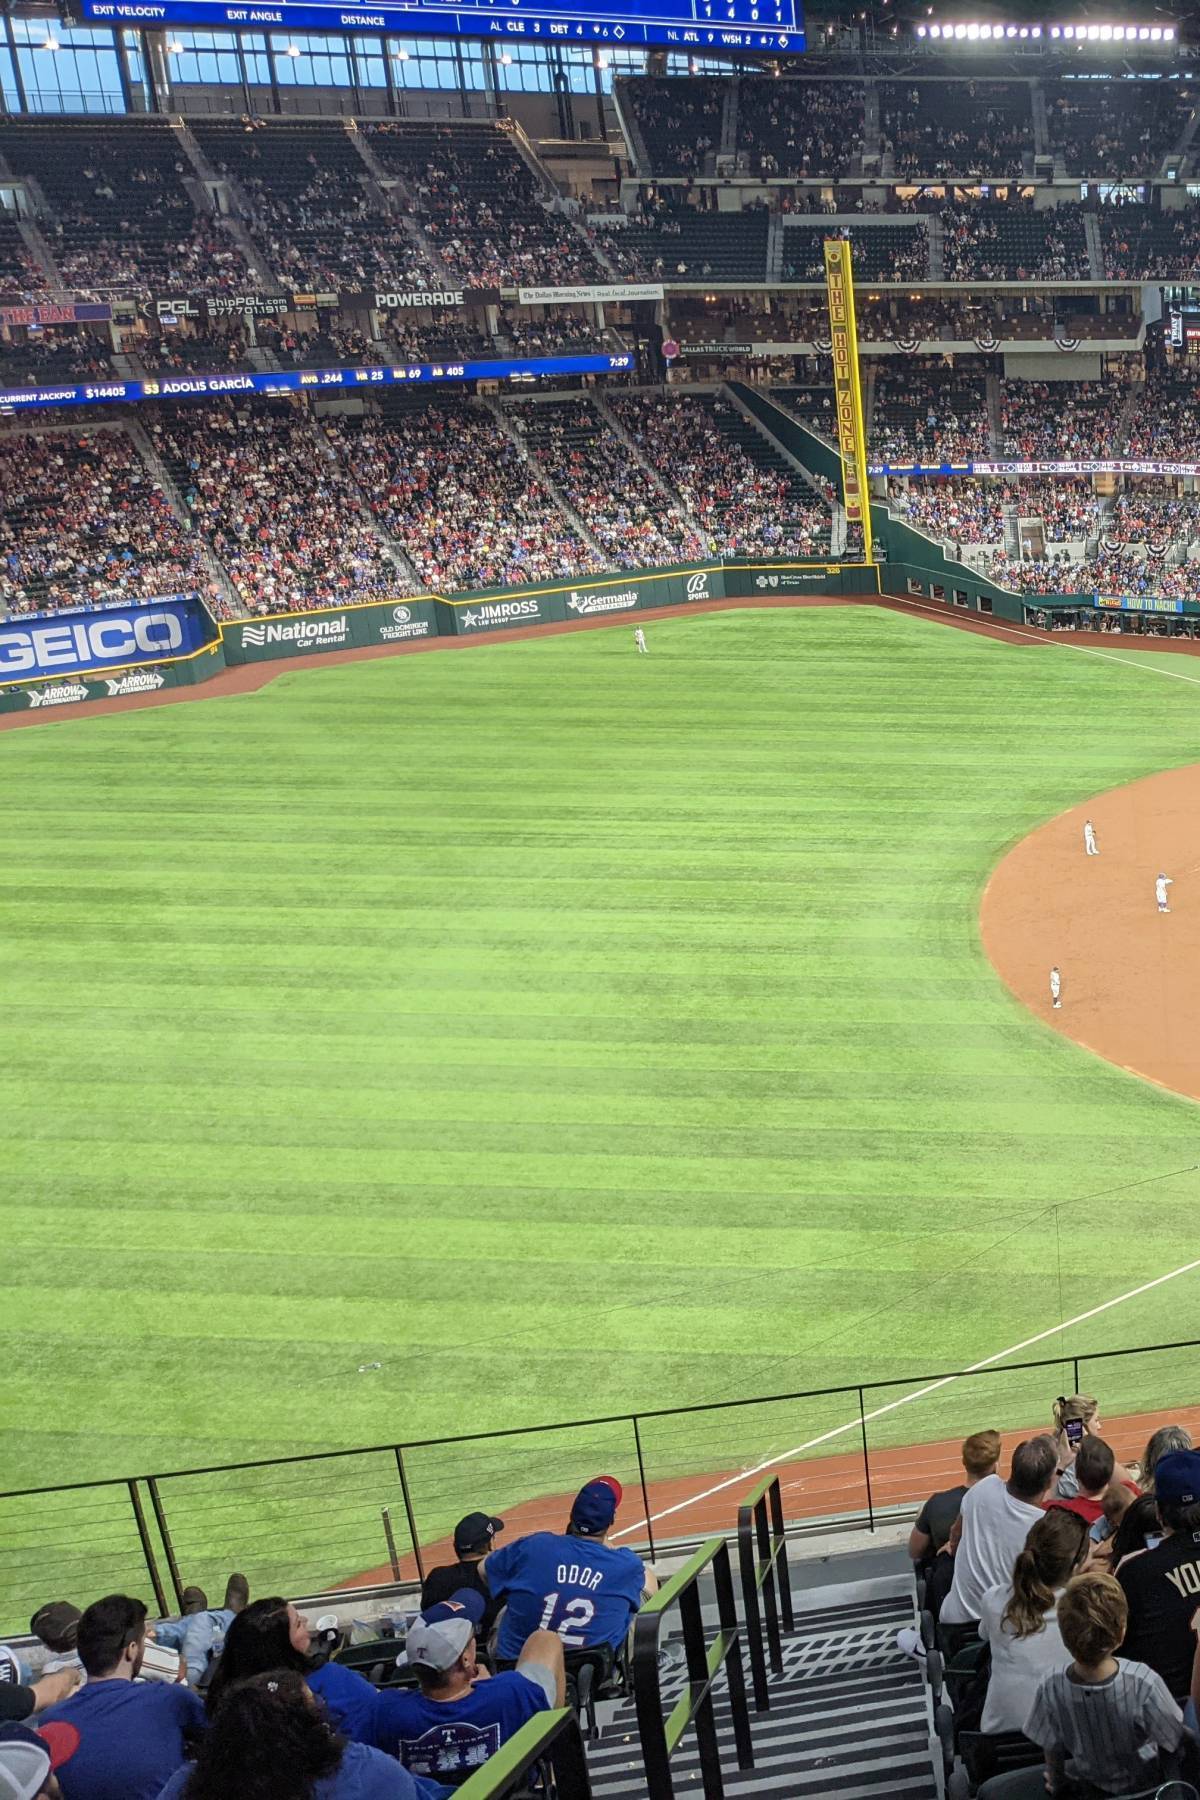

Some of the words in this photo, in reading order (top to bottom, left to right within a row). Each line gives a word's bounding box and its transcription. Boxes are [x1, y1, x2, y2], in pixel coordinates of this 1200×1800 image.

[93, 5, 114, 16] EXIT
[117, 6, 165, 17] VELOCITY
[227, 10, 247, 20] EXIT
[250, 11, 282, 21] ANGLE
[705, 5, 711, 17] 1
[728, 7, 735, 19] 4
[752, 9, 759, 20] 0
[776, 11, 781, 22] 1
[341, 15, 385, 26] DISTANCE
[490, 22, 502, 31] AL
[507, 23, 525, 32] CLE
[534, 24, 540, 32] 3
[551, 24, 569, 34] DET
[577, 26, 583, 35] 4
[603, 28, 608, 36] 6
[667, 30, 679, 41] NL
[684, 31, 699, 42] ATL
[708, 33, 714, 42] 9
[722, 34, 741, 44] WSH
[746, 36, 751, 44] 2
[769, 37, 774, 46] 7
[206, 297, 287, 308] ShipPGL.com
[375, 292, 464, 308] POWERADE
[831, 275, 842, 321] THE
[157, 301, 198, 315] PGL
[208, 306, 288, 316] 877.701.1919
[609, 357, 629, 367] 7:29
[835, 333, 847, 378] HOT
[301, 375, 319, 384] AVG
[322, 373, 343, 384] .244
[371, 371, 384, 381] 25
[409, 369, 421, 379] 69
[432, 367, 443, 376] AB
[446, 366, 464, 376] 405
[144, 384, 160, 394] 53
[163, 380, 207, 393] ADOLIS
[209, 376, 254, 390] GARCÍA
[0, 394, 37, 403] CURRENT
[39, 391, 77, 401] JACKPOT
[86, 387, 126, 398] $14405
[840, 392, 853, 450] ZONE
[588, 591, 637, 606] Germania
[687, 592, 710, 601] SPORTS
[105, 601, 132, 609] GEICO
[10, 613, 38, 622] GEICO
[478, 618, 489, 626] LAW
[394, 621, 429, 632] DOMINION
[412, 628, 428, 636] LINE
[0, 613, 183, 673] GEICO
[297, 639, 312, 648] Car
[316, 634, 346, 644] Rental
[121, 674, 156, 688] ARROW
[43, 685, 79, 700] ARROW
[557, 1564, 603, 1591] ODOR
[539, 1593, 595, 1646] 12
[442, 1729, 456, 1743] T
